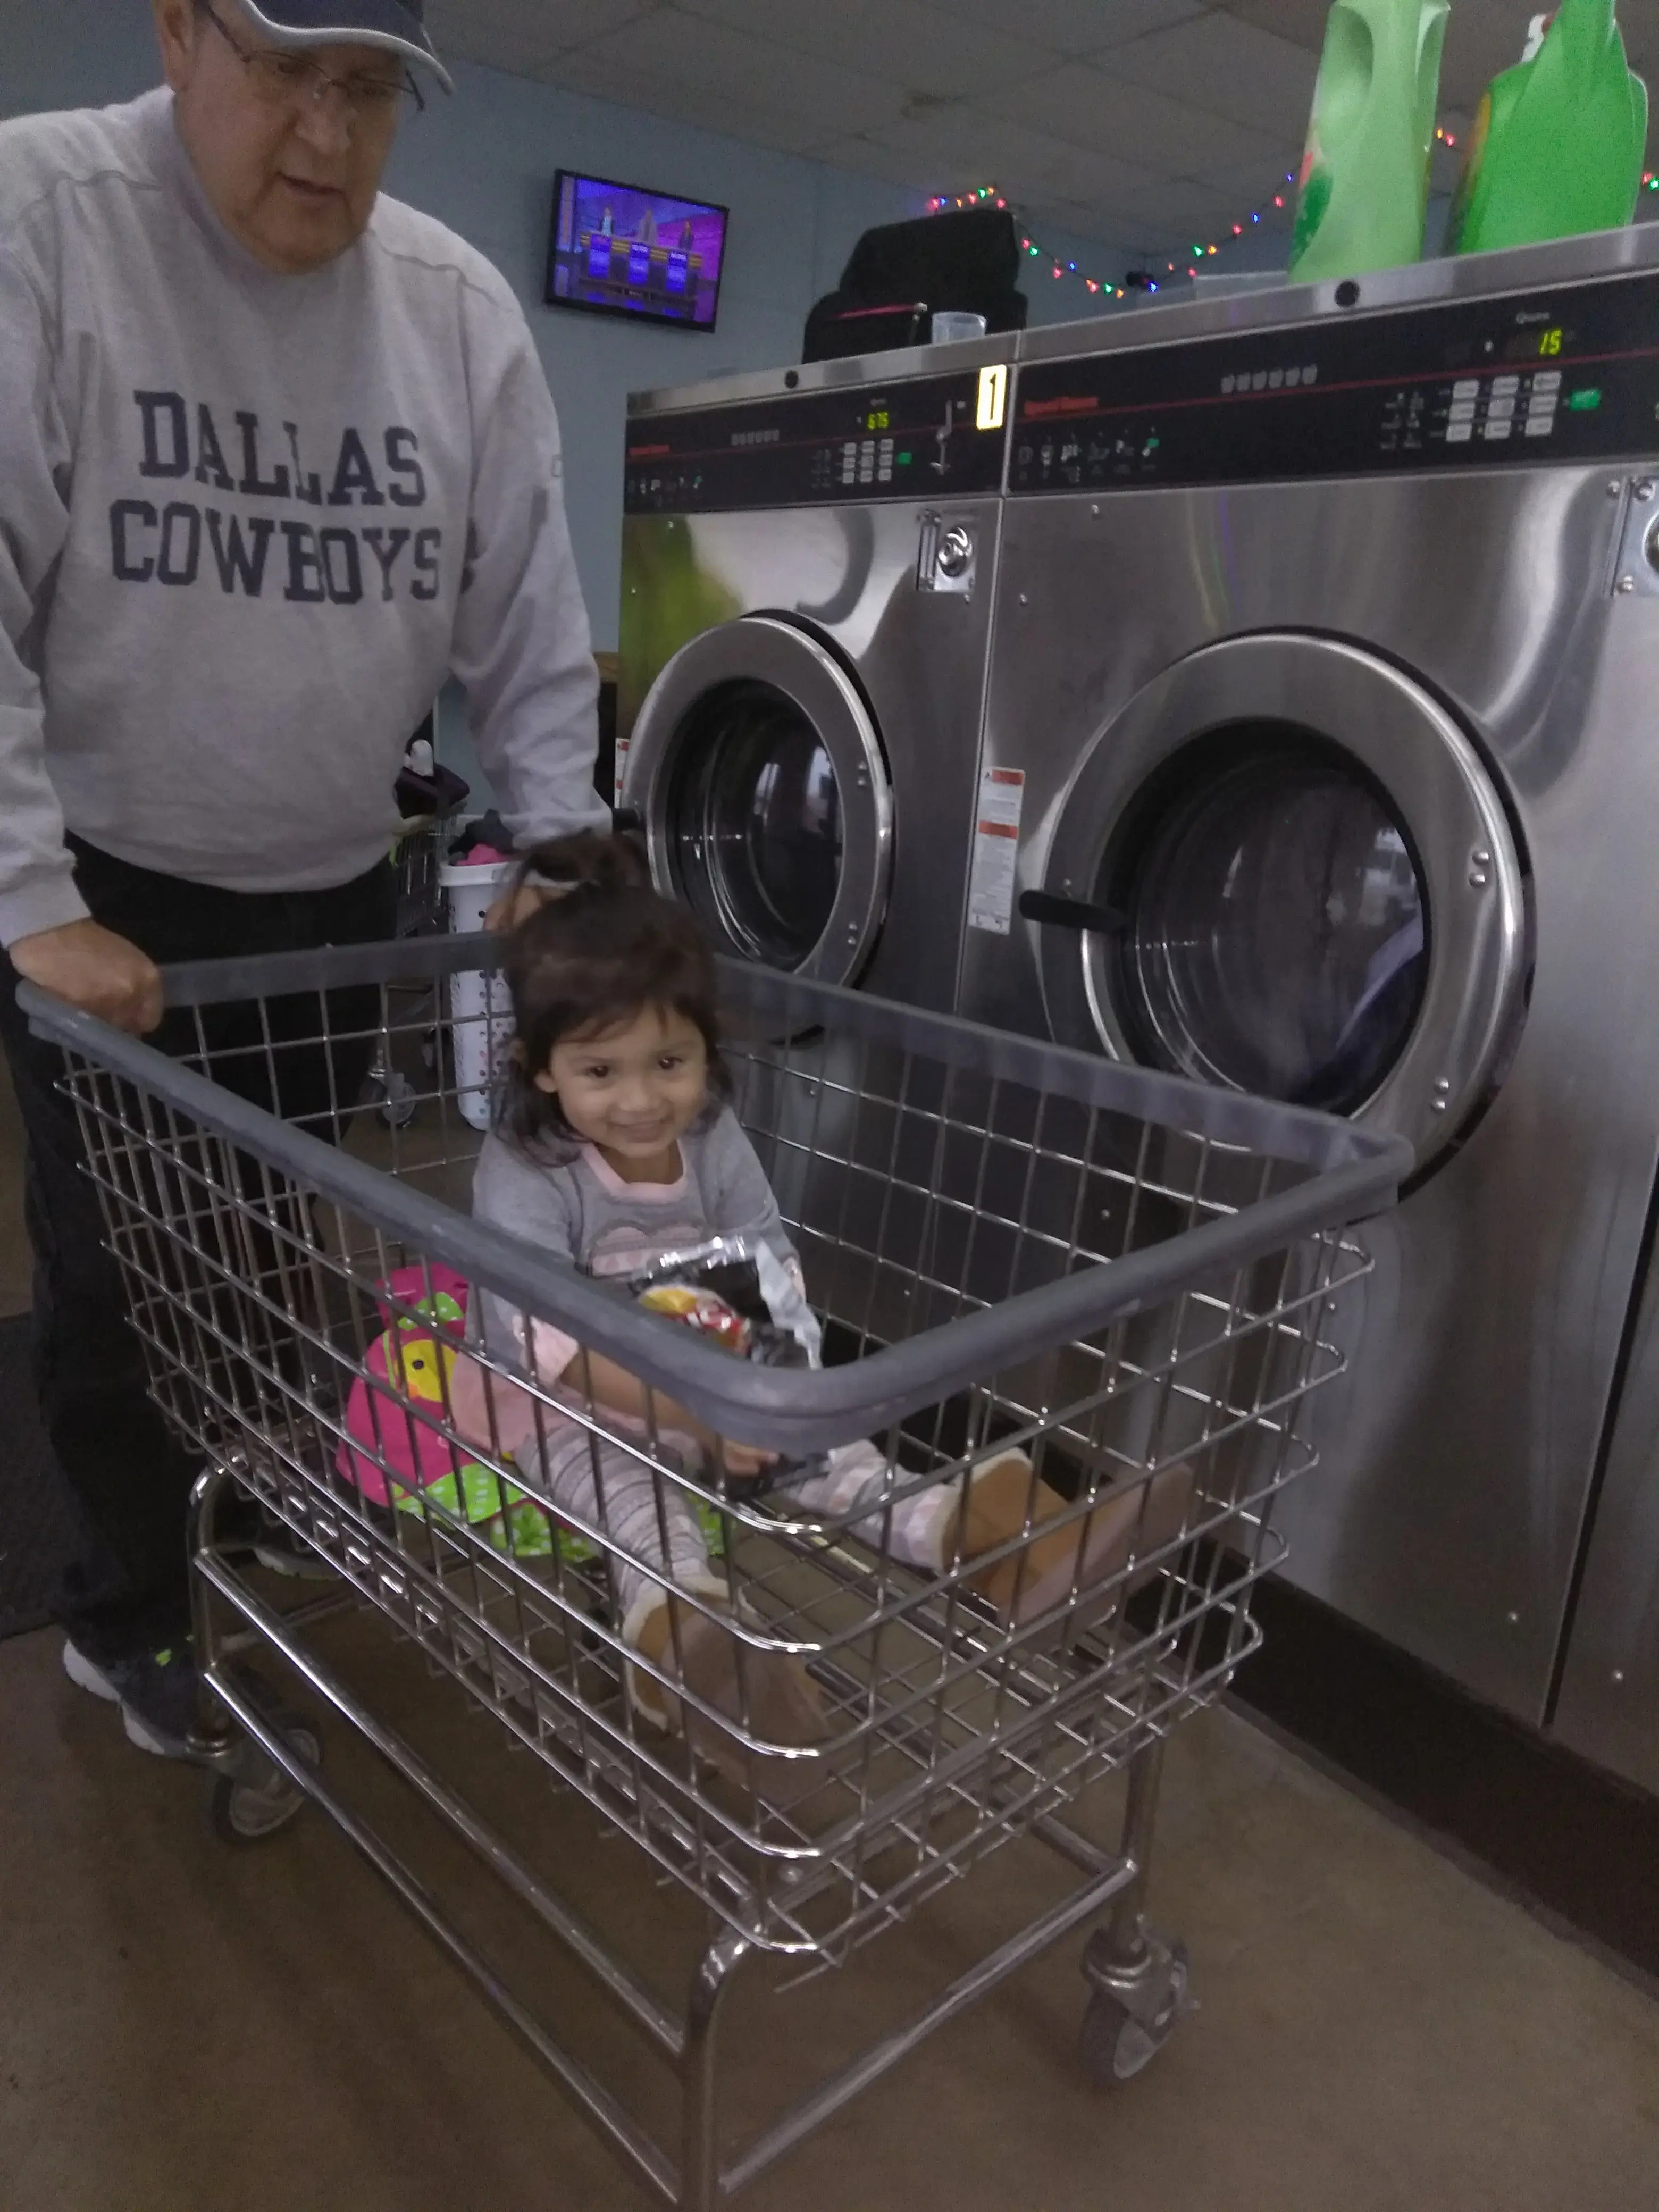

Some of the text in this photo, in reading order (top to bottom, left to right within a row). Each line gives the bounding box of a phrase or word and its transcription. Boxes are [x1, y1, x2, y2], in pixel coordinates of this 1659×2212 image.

[1540, 328, 1562, 355] 15
[989, 373, 996, 420] 1
[133, 389, 426, 506] DALLAS
[110, 499, 441, 604] COWBOYS
